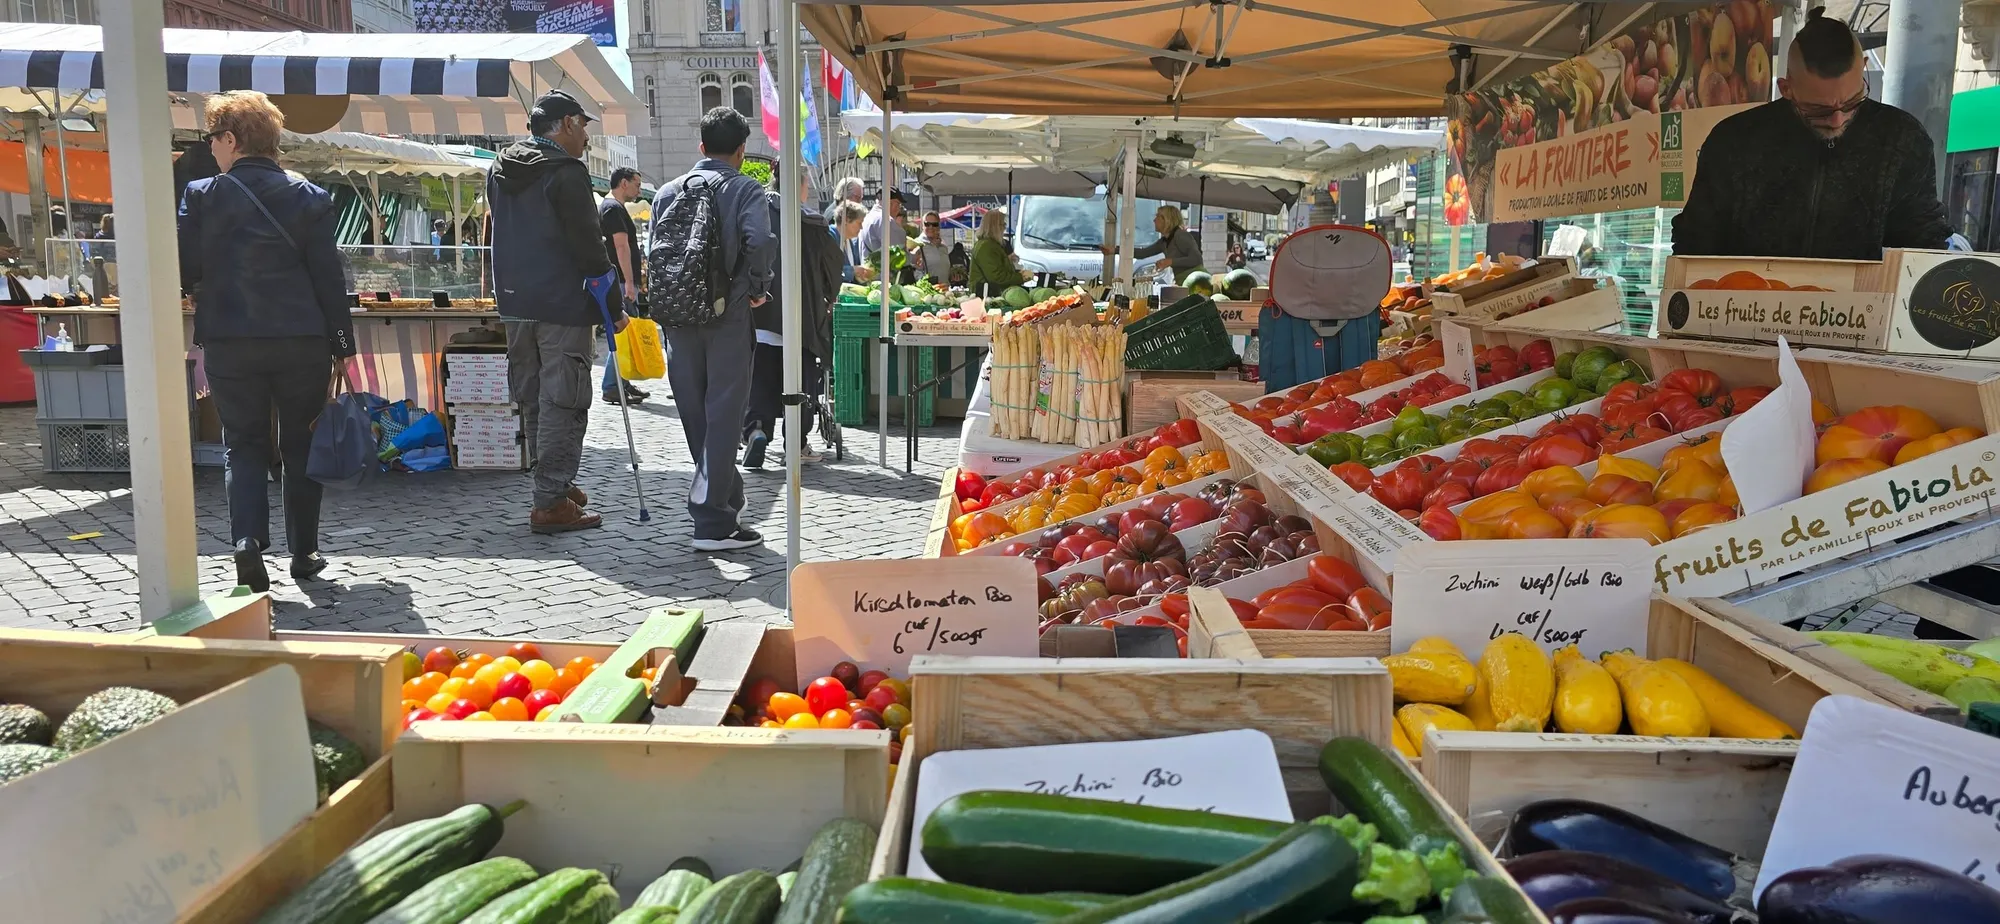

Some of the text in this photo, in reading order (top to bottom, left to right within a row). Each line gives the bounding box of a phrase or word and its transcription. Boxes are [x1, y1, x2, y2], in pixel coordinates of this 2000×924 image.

[536, 1, 594, 28] SCREAM
[536, 5, 604, 33] MACHINES
[1663, 124, 1678, 148] AB
[1516, 129, 1631, 191] LA FRUITIERE
[1508, 182, 1648, 211] PRODUCTION LOCALE DE FRUITS DE SAISON
[1698, 298, 1866, 330] Les fruits de Fabiola
[1912, 306, 1926, 314] Les
[1928, 310, 1951, 322] fruits
[1954, 317, 1964, 328] de
[1804, 330, 1822, 338] ROUX
[1832, 332, 1866, 341] PROVENCE
[1654, 464, 1994, 594] fruits de Fabiola
[1760, 487, 1998, 572] PAR LA FAMILLE ROUX EN PROVENCE
[985, 586, 1012, 602] Bio
[1445, 571, 1500, 592] Zuchini
[1600, 572, 1622, 586] Bio
[1718, 738, 1800, 746] Fabiol
[1143, 768, 1182, 788] Bio
